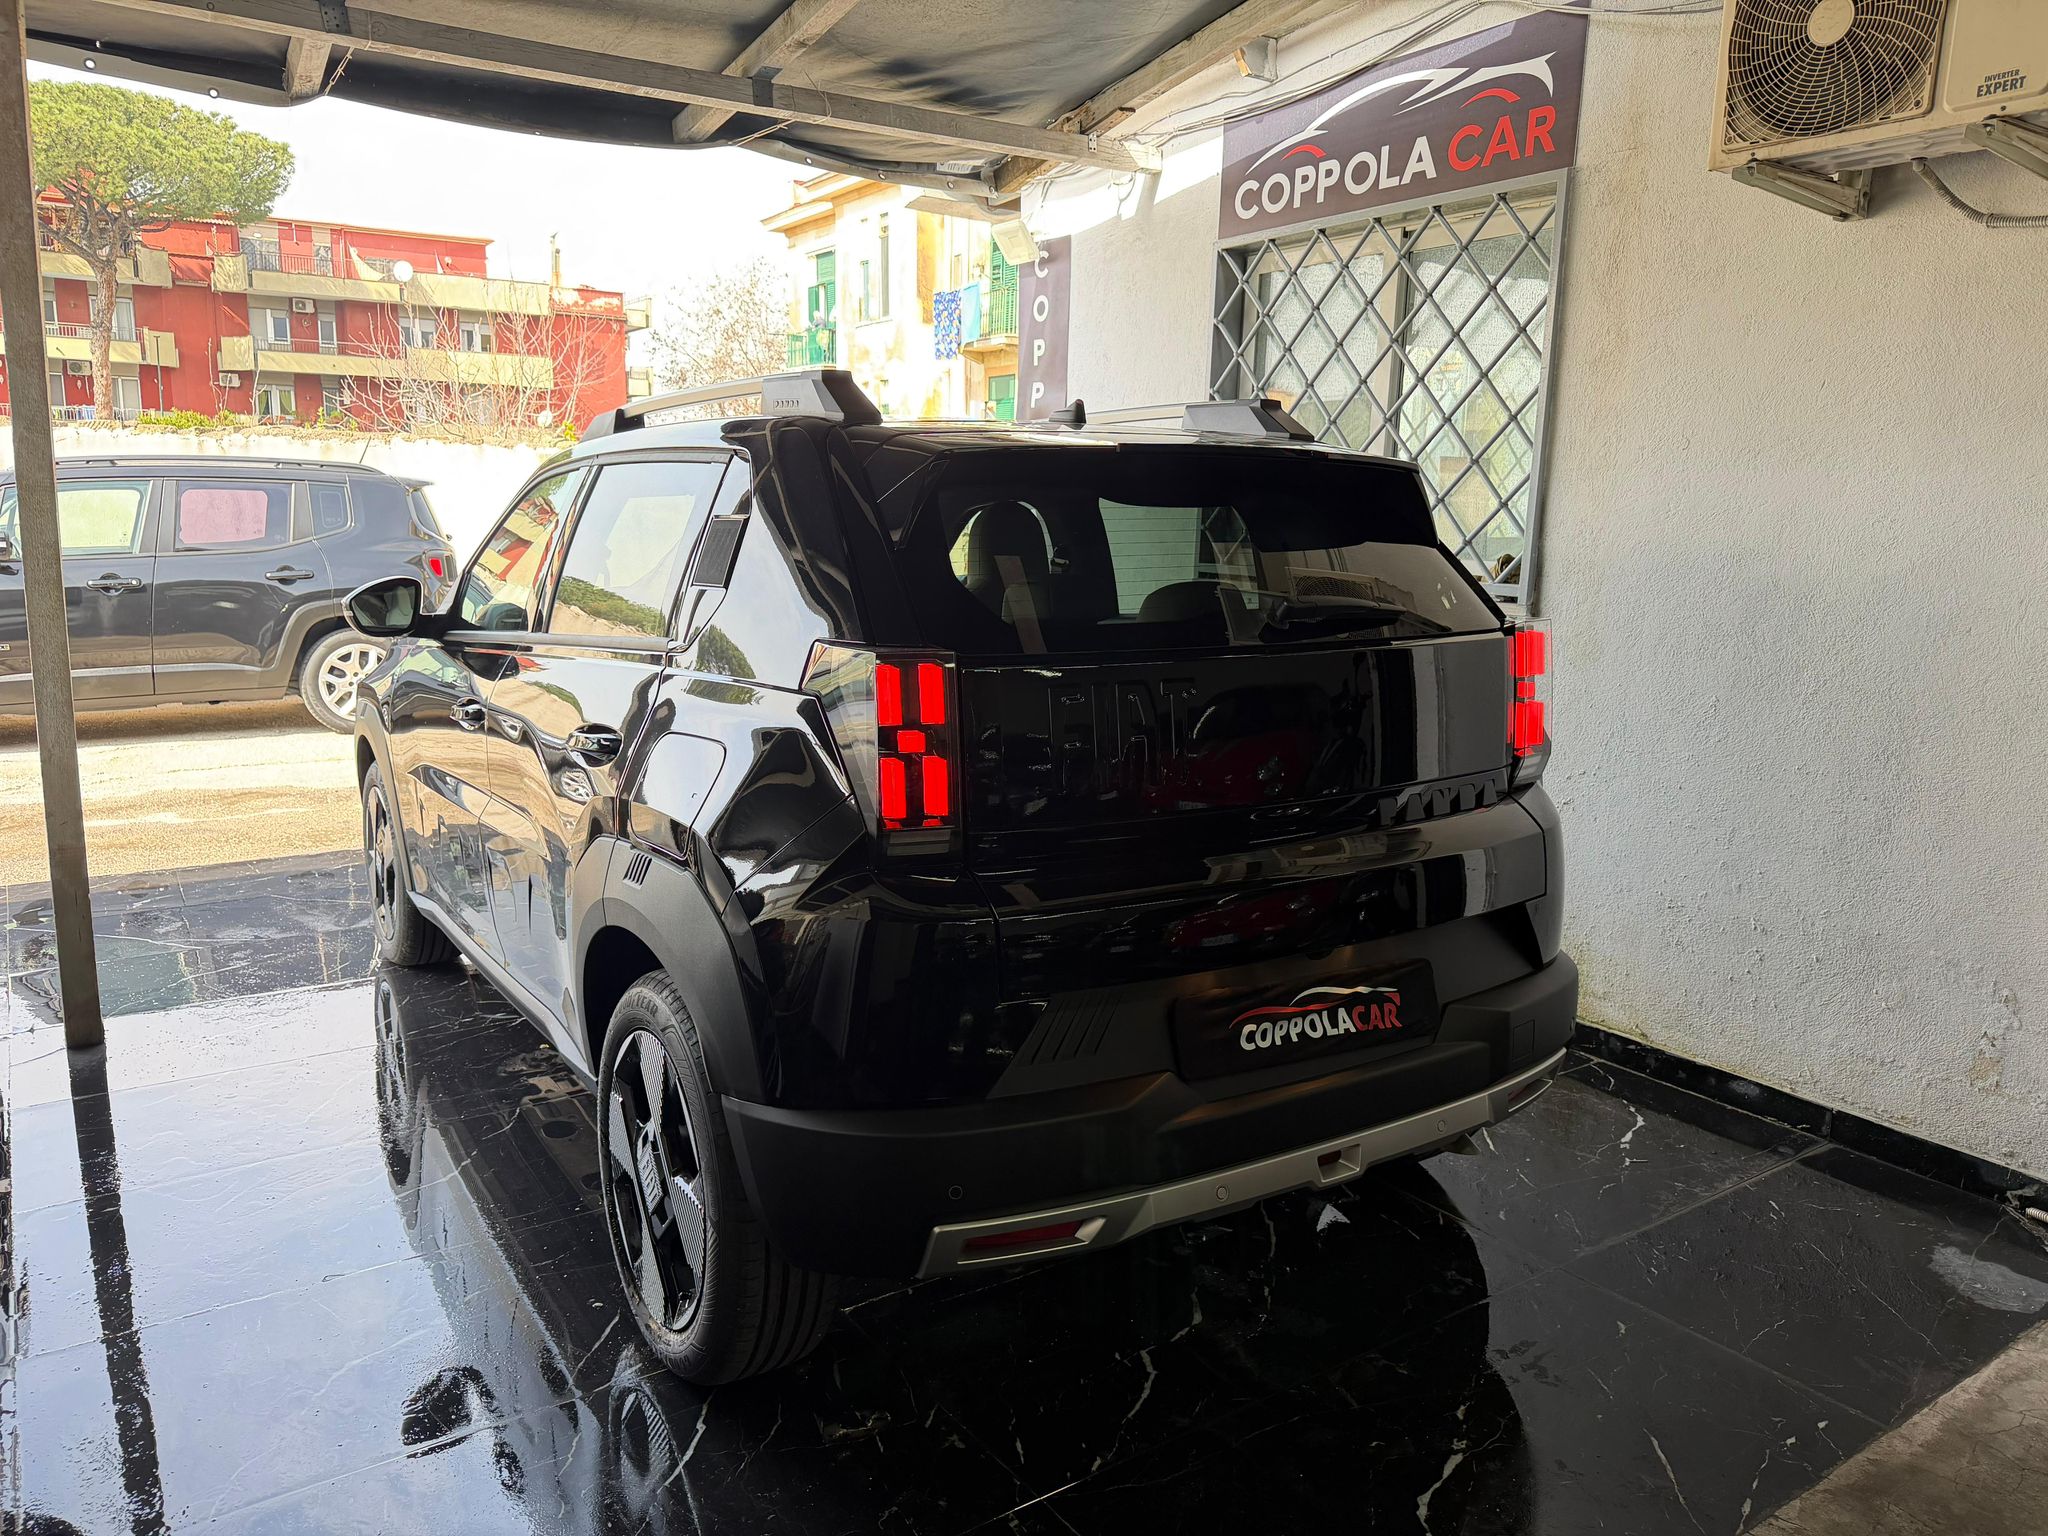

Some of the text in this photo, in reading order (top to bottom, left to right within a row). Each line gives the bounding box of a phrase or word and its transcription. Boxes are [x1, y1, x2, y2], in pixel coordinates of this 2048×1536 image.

[1977, 76, 2027, 97] EXPERT
[1984, 69, 2020, 83] INVERTER
[1234, 105, 1557, 220] COPPOLA CAR
[1047, 677, 1199, 788] FIAT
